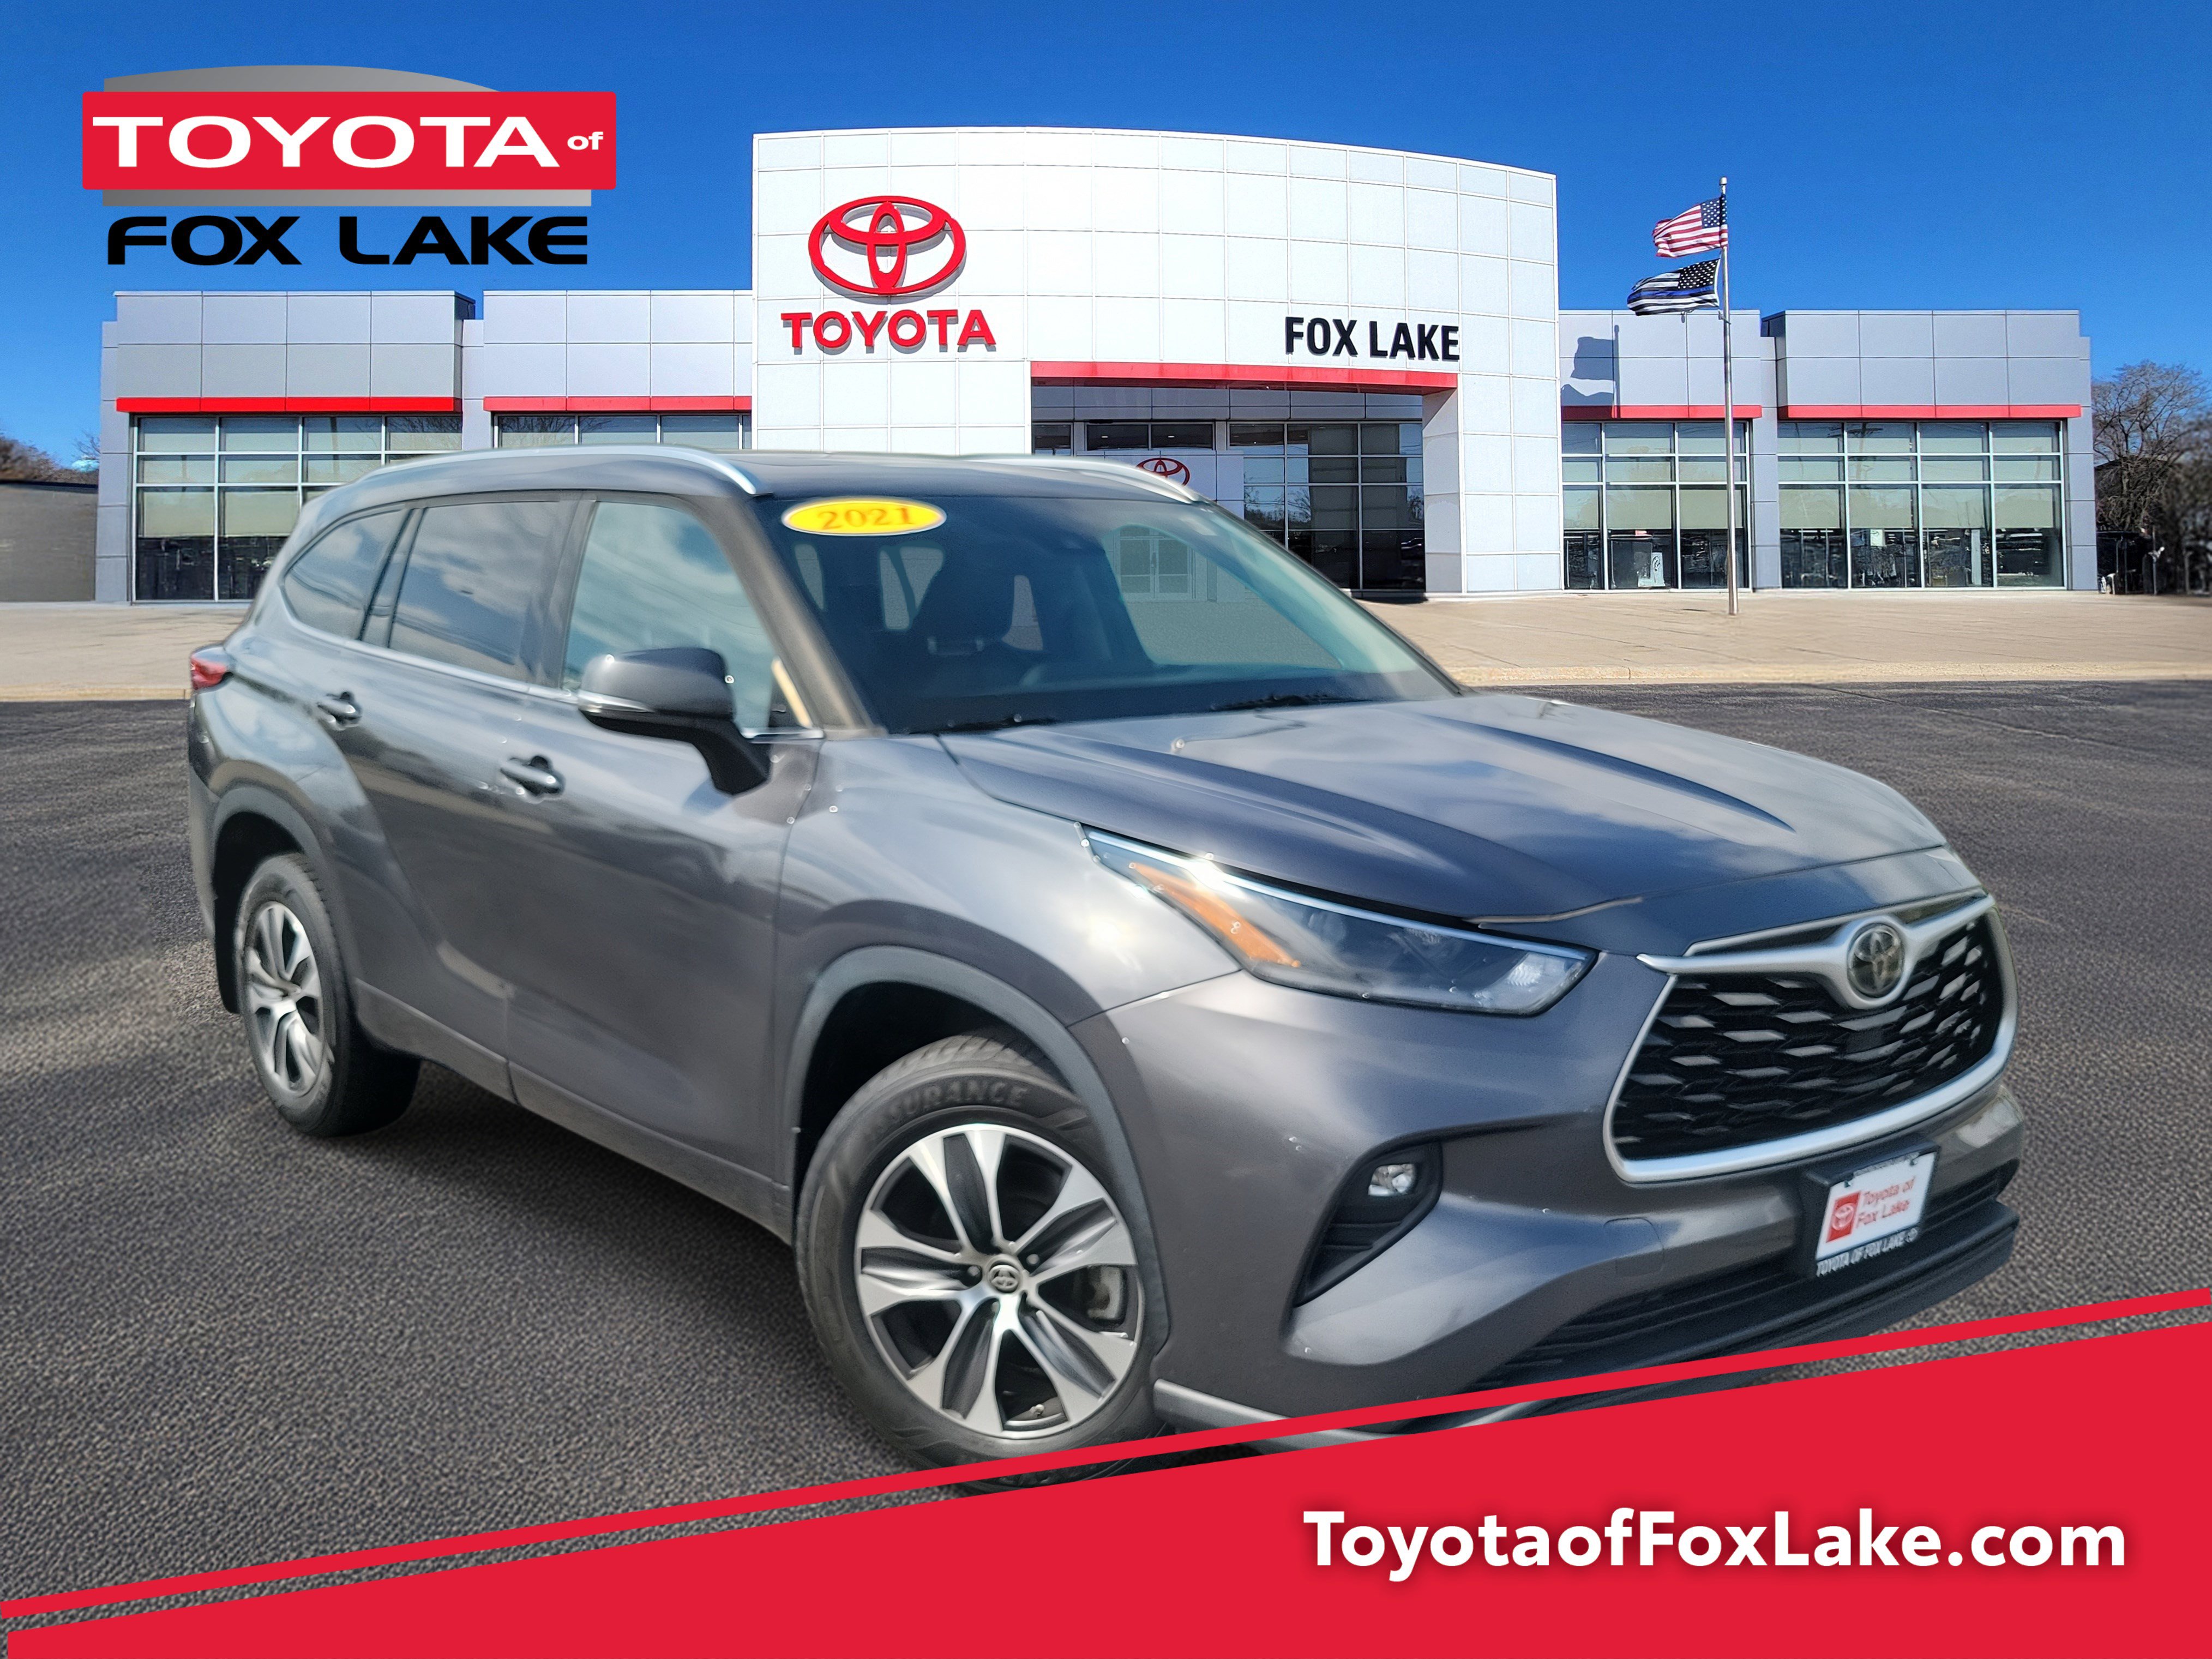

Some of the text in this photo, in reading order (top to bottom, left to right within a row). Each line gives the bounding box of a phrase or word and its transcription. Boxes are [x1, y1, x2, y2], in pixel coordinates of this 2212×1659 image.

[781, 309, 996, 348] TOYOTA
[1285, 316, 1460, 360] FOX LAKE
[818, 508, 916, 530] 2021
[1864, 1176, 1916, 1205] Toyota of
[1856, 1200, 1910, 1228] Fox Lake
